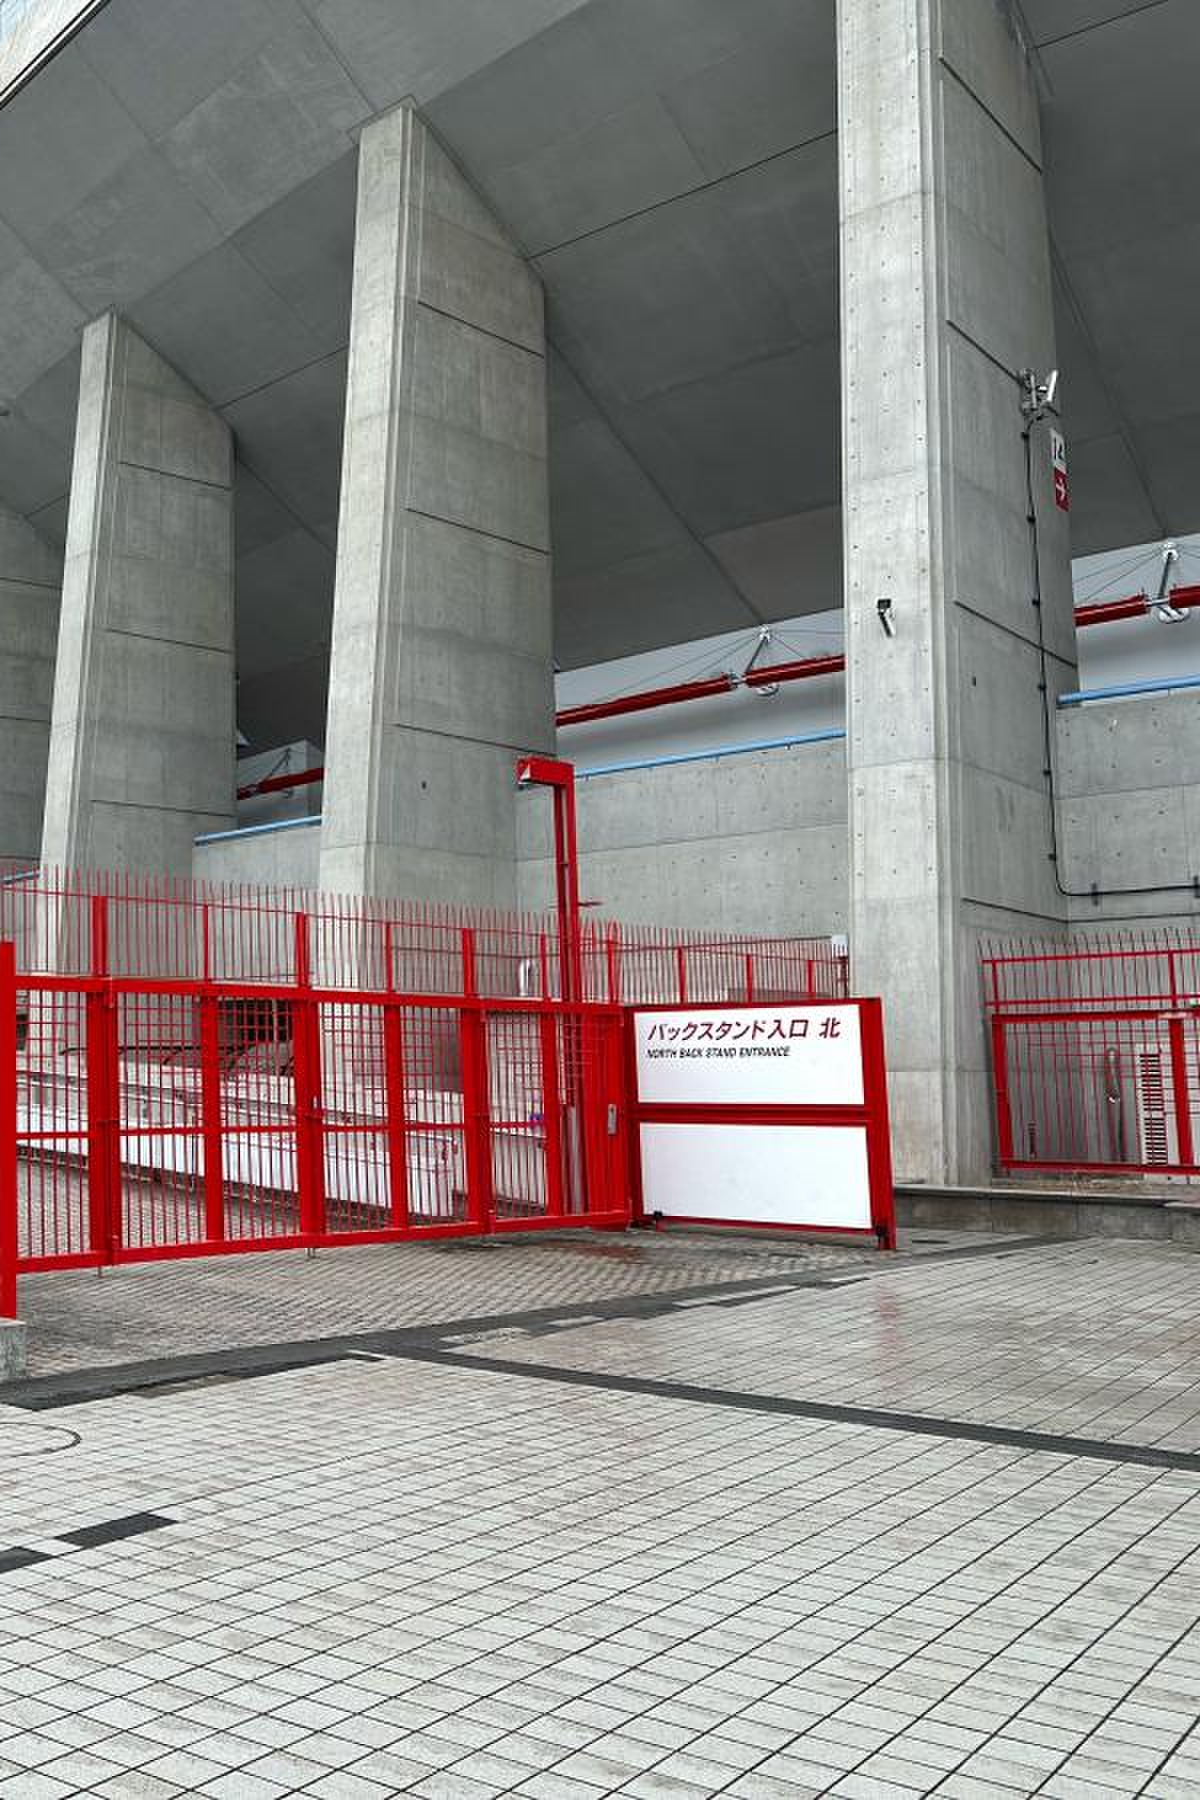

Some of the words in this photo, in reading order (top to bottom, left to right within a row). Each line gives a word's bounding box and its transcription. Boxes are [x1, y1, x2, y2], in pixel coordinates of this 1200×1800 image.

[647, 1018, 809, 1041] バックスタンド入口
[818, 1017, 841, 1039] 北
[647, 1049, 677, 1059] NORTH
[679, 1048, 703, 1058] BACK
[705, 1047, 737, 1058] STAND
[739, 1046, 790, 1057] ENTRANCE
